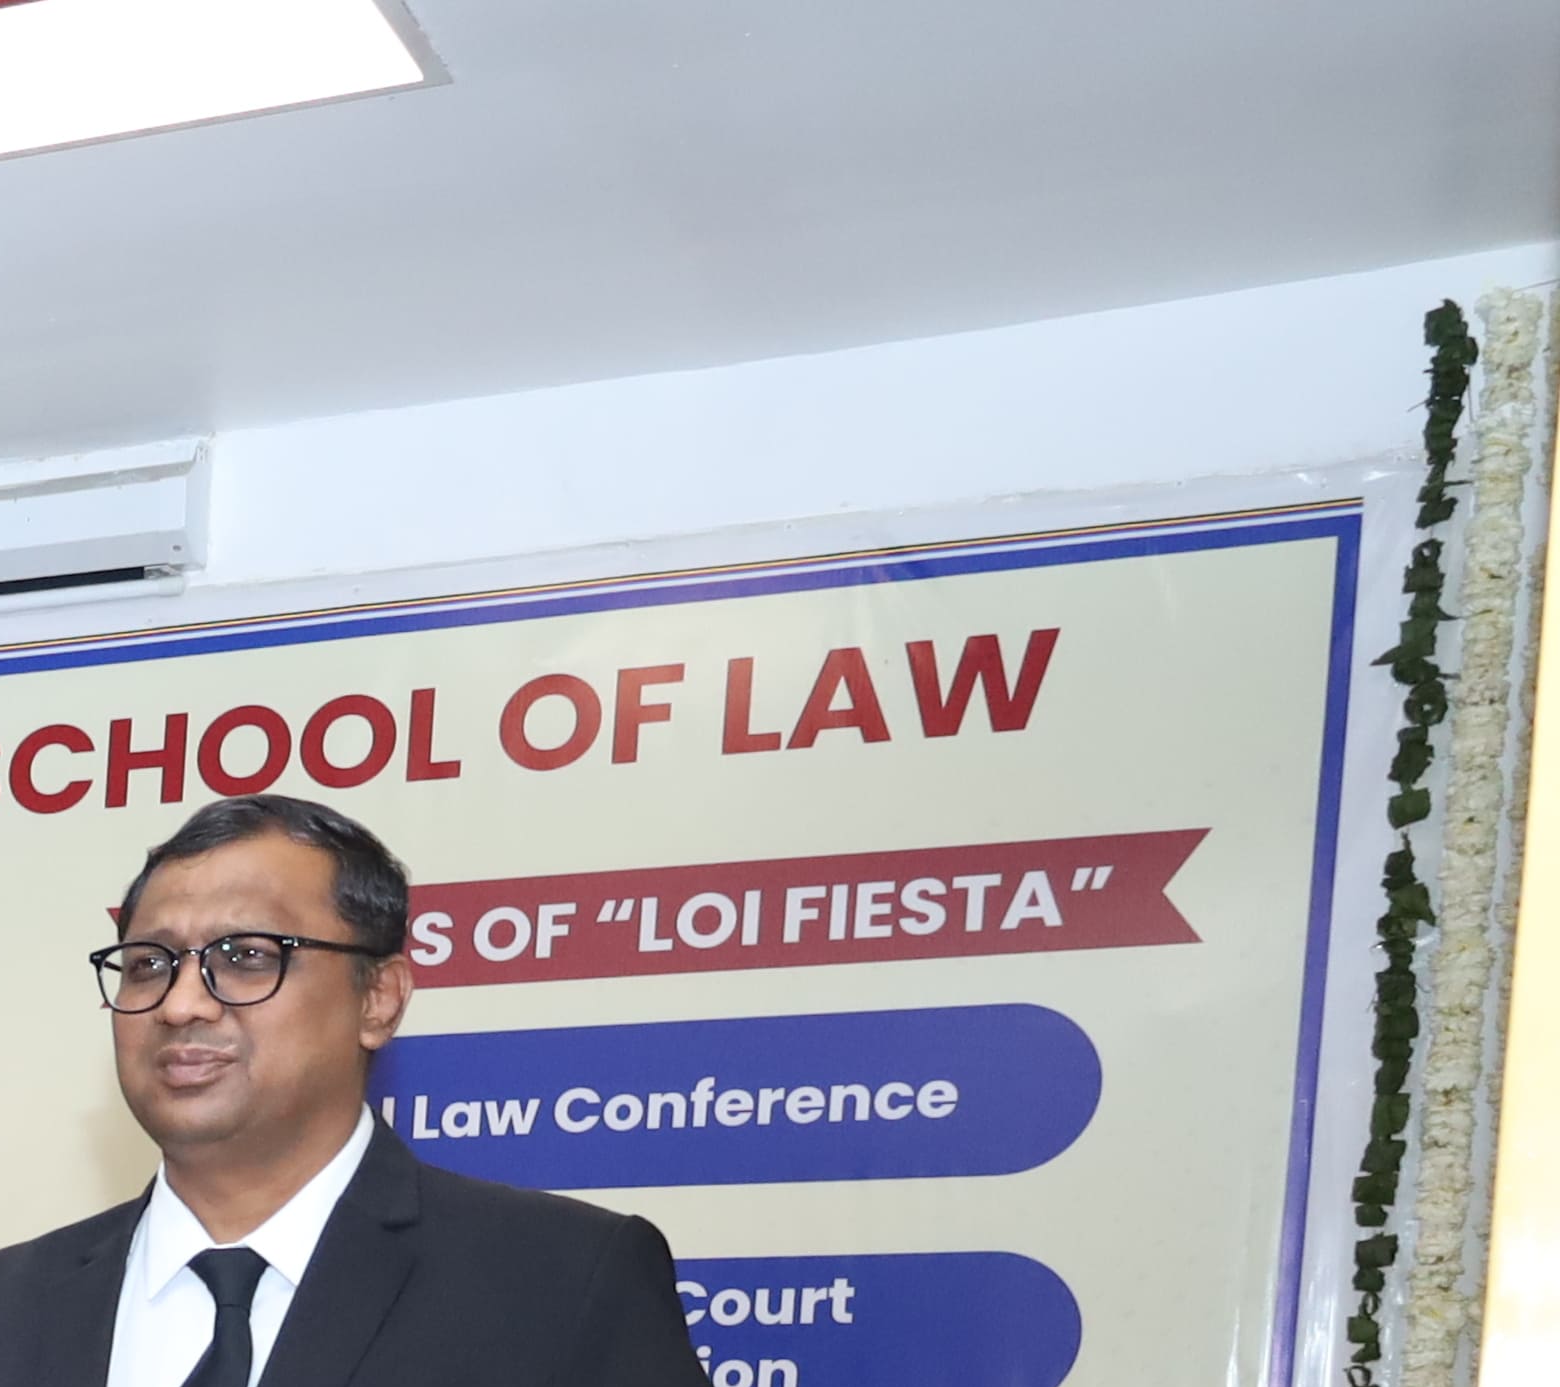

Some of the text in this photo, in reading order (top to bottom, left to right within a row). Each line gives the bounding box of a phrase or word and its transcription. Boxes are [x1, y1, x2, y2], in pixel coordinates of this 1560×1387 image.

[500, 663, 685, 772] OF
[723, 627, 1060, 755] LAW
[472, 901, 578, 963] OF
[412, 1095, 541, 1140] Law
[553, 1077, 959, 1134] Conference
